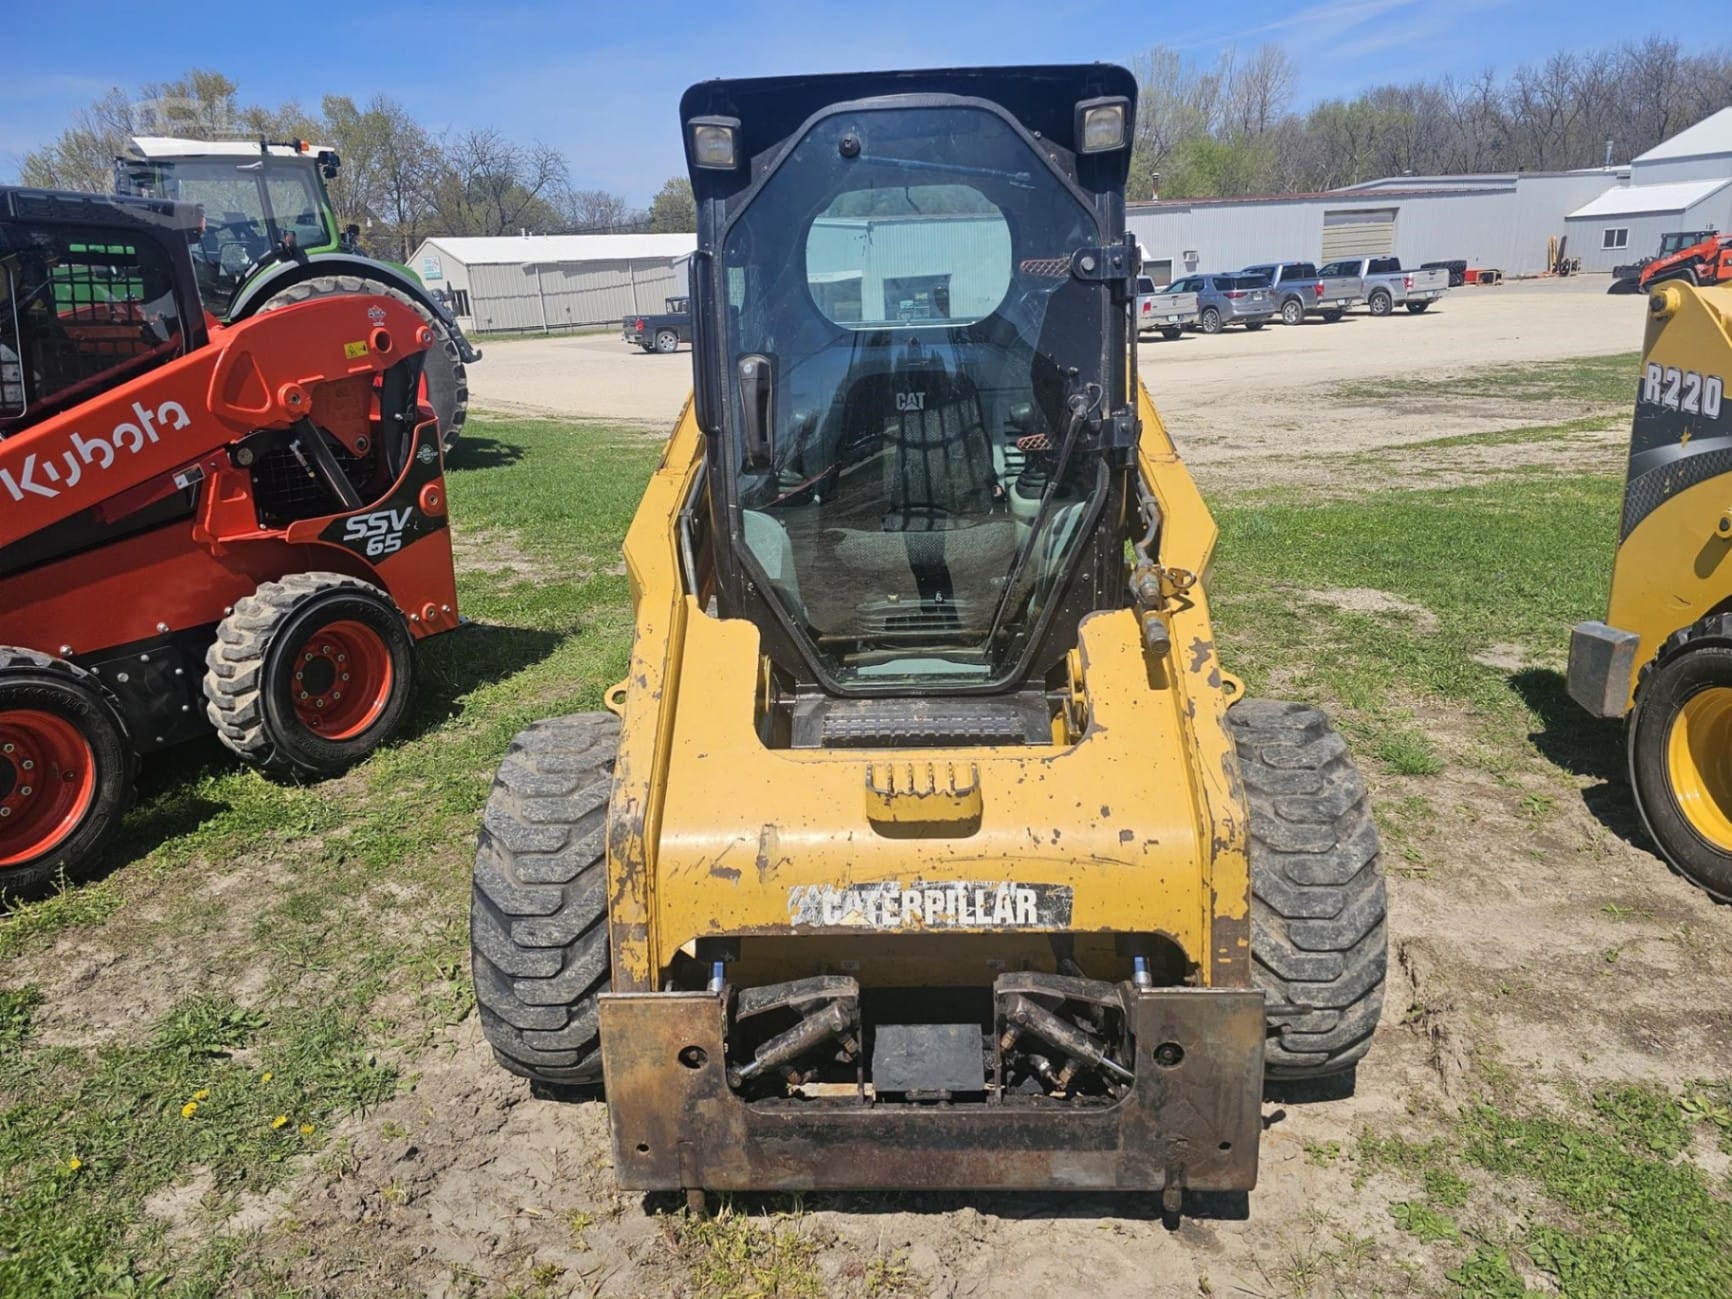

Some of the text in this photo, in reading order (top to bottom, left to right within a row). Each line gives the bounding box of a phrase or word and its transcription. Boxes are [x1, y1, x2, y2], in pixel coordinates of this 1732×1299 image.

[896, 391, 926, 411] CAT
[1643, 363, 1724, 419] R220
[0, 400, 191, 501] Kubota
[343, 506, 413, 541] SSV
[366, 532, 402, 556] 65
[822, 885, 1038, 927] CATERPILLAR
